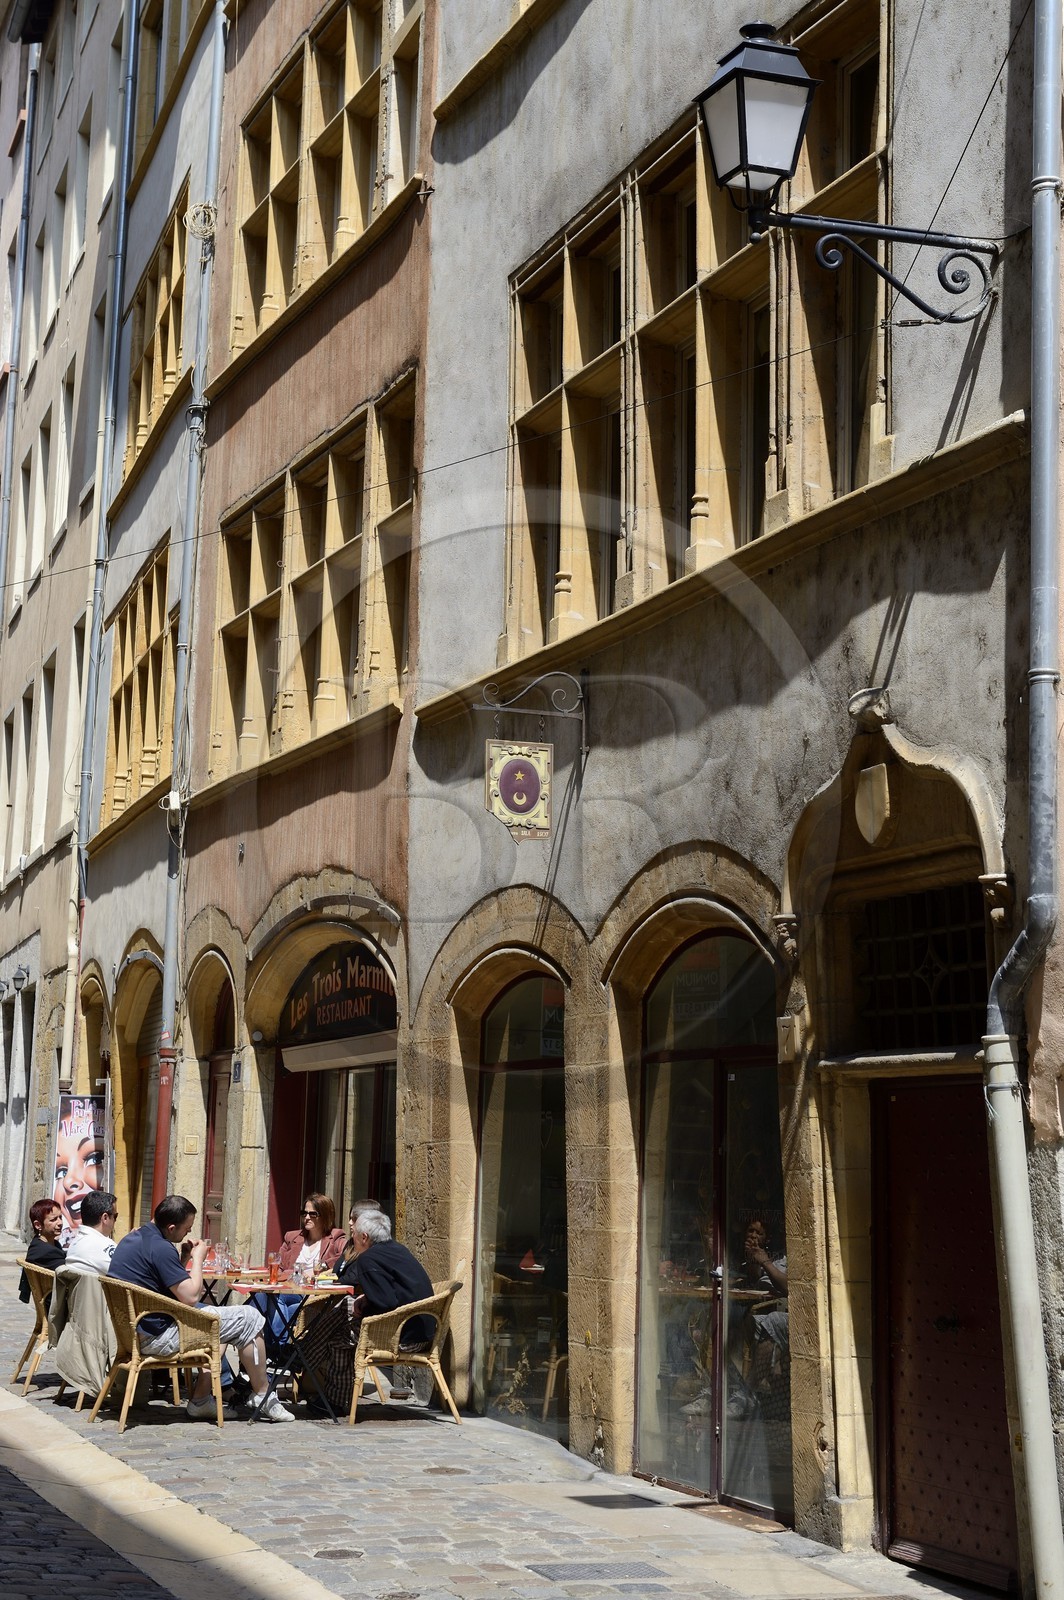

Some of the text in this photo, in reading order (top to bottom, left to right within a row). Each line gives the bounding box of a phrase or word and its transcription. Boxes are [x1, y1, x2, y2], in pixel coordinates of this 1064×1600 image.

[290, 992, 309, 1029] Les
[312, 960, 342, 1006] Trois
[316, 995, 372, 1025] RESTAURANT
[781, 1024, 791, 1054] 7
